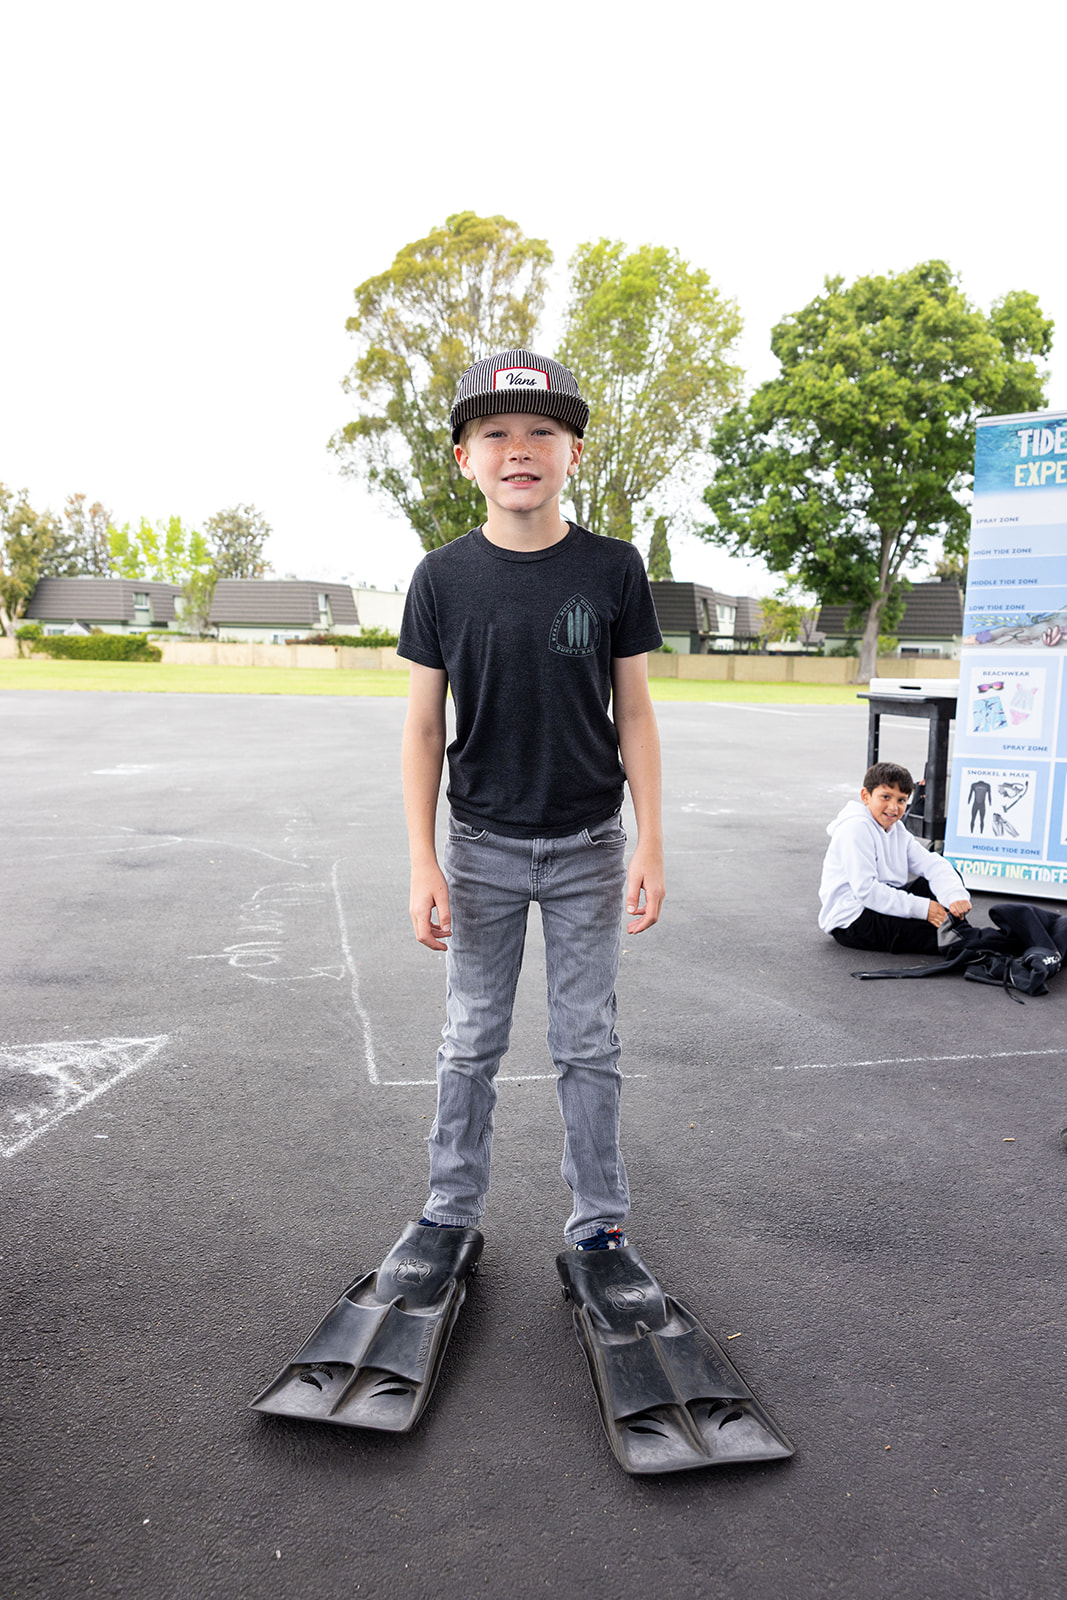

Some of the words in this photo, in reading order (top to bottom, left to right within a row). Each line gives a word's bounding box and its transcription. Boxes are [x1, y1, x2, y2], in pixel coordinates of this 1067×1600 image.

[505, 371, 538, 386] Vans
[1017, 426, 1067, 458] TIDE
[1014, 460, 1067, 487] EXPE
[972, 844, 999, 852] MIDDLE
